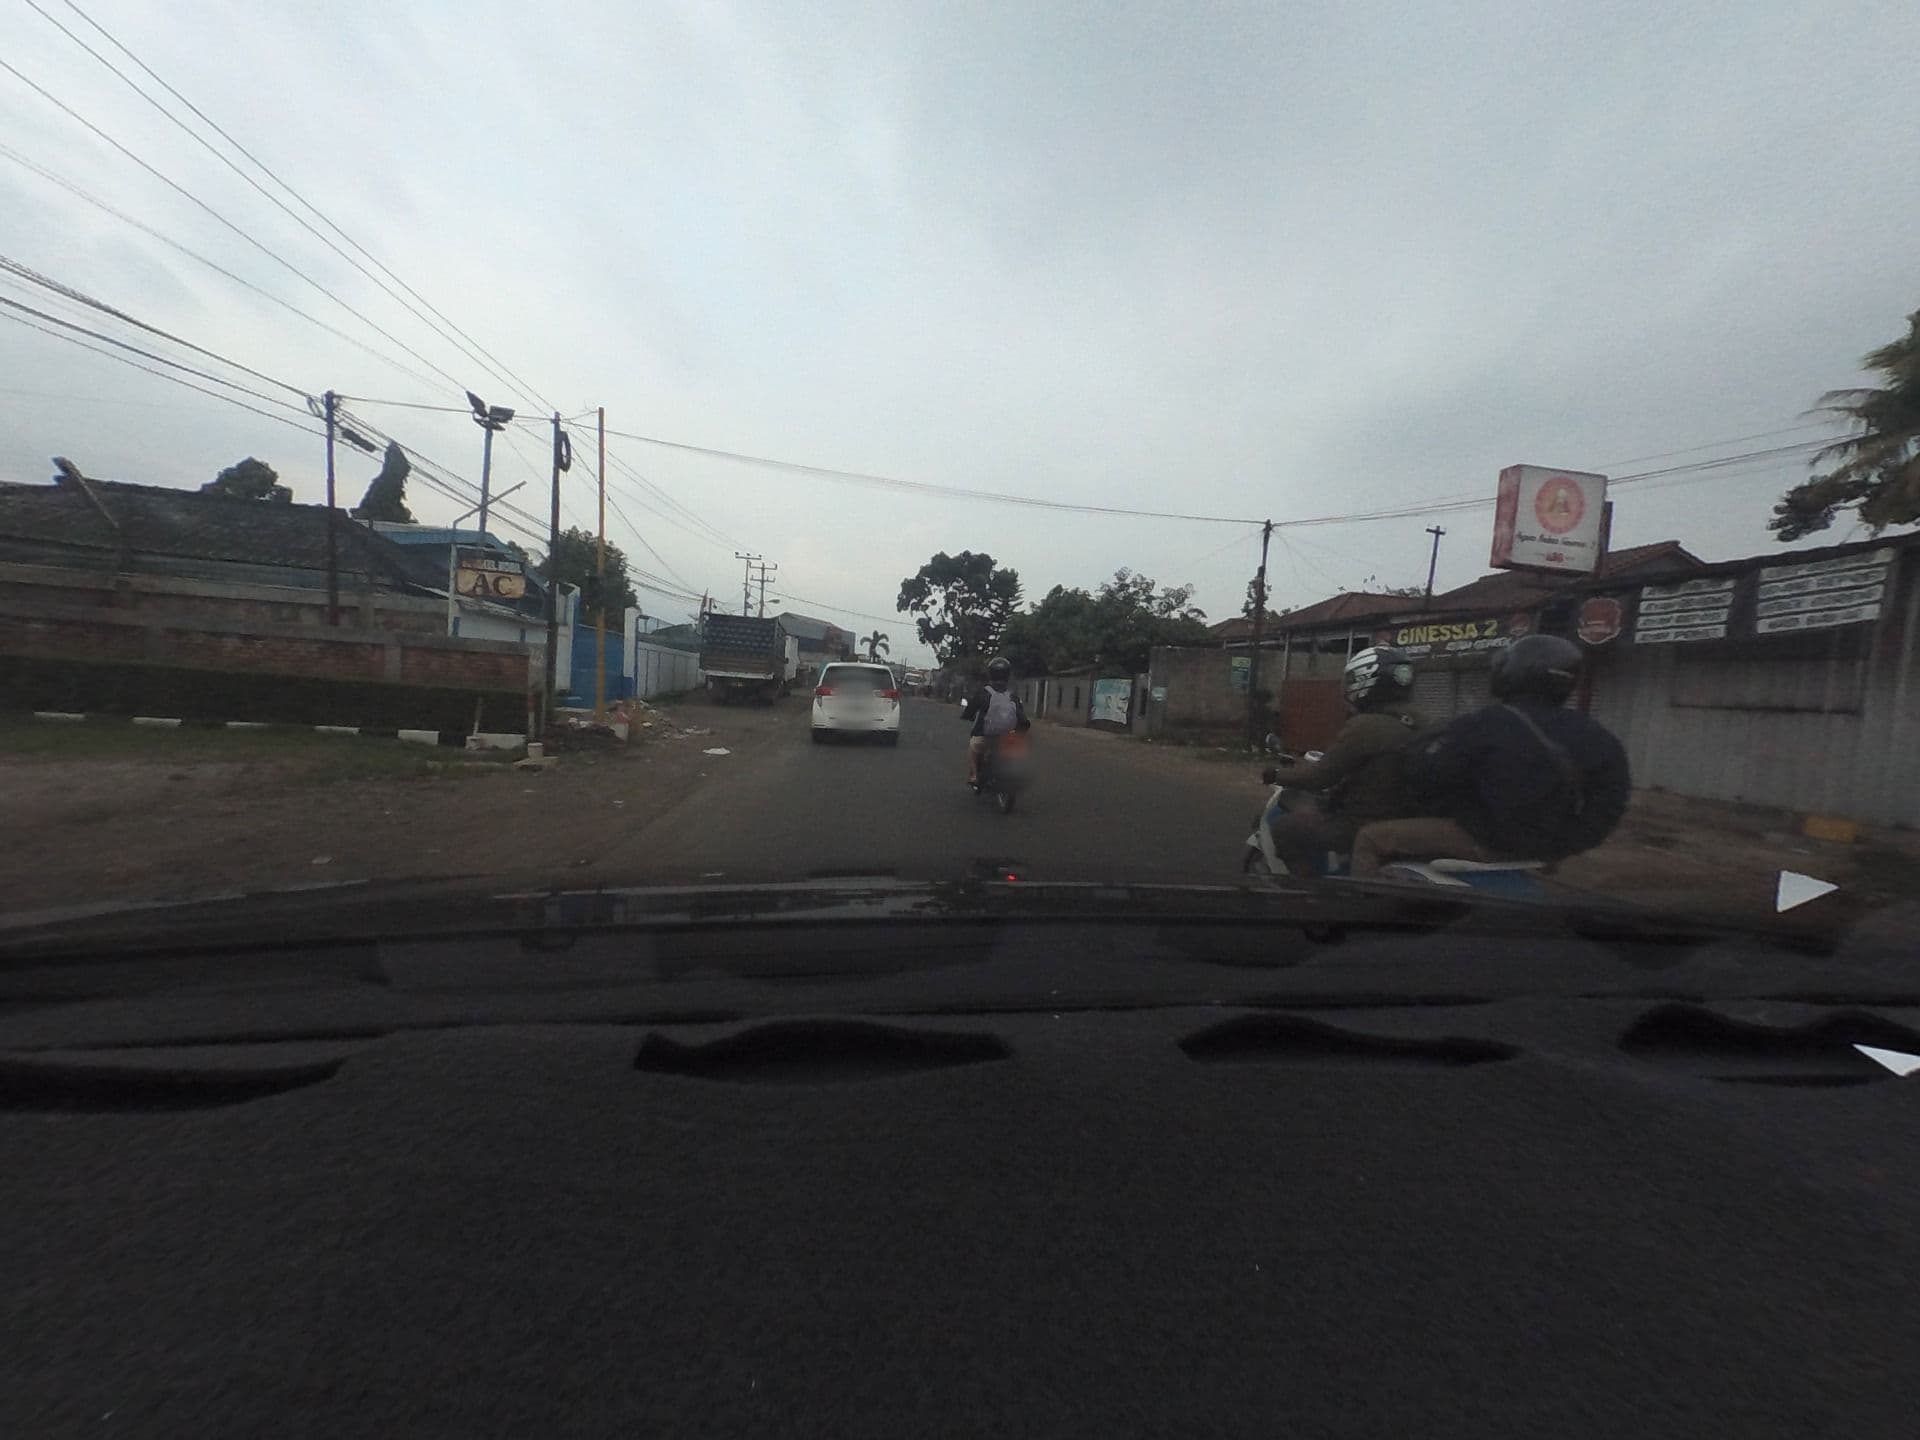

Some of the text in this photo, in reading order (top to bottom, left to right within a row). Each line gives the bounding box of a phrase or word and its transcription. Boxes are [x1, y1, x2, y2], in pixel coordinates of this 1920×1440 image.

[472, 573, 512, 596] AC
[1397, 622, 1478, 645] GINESSA
[1483, 619, 1498, 637] 2
